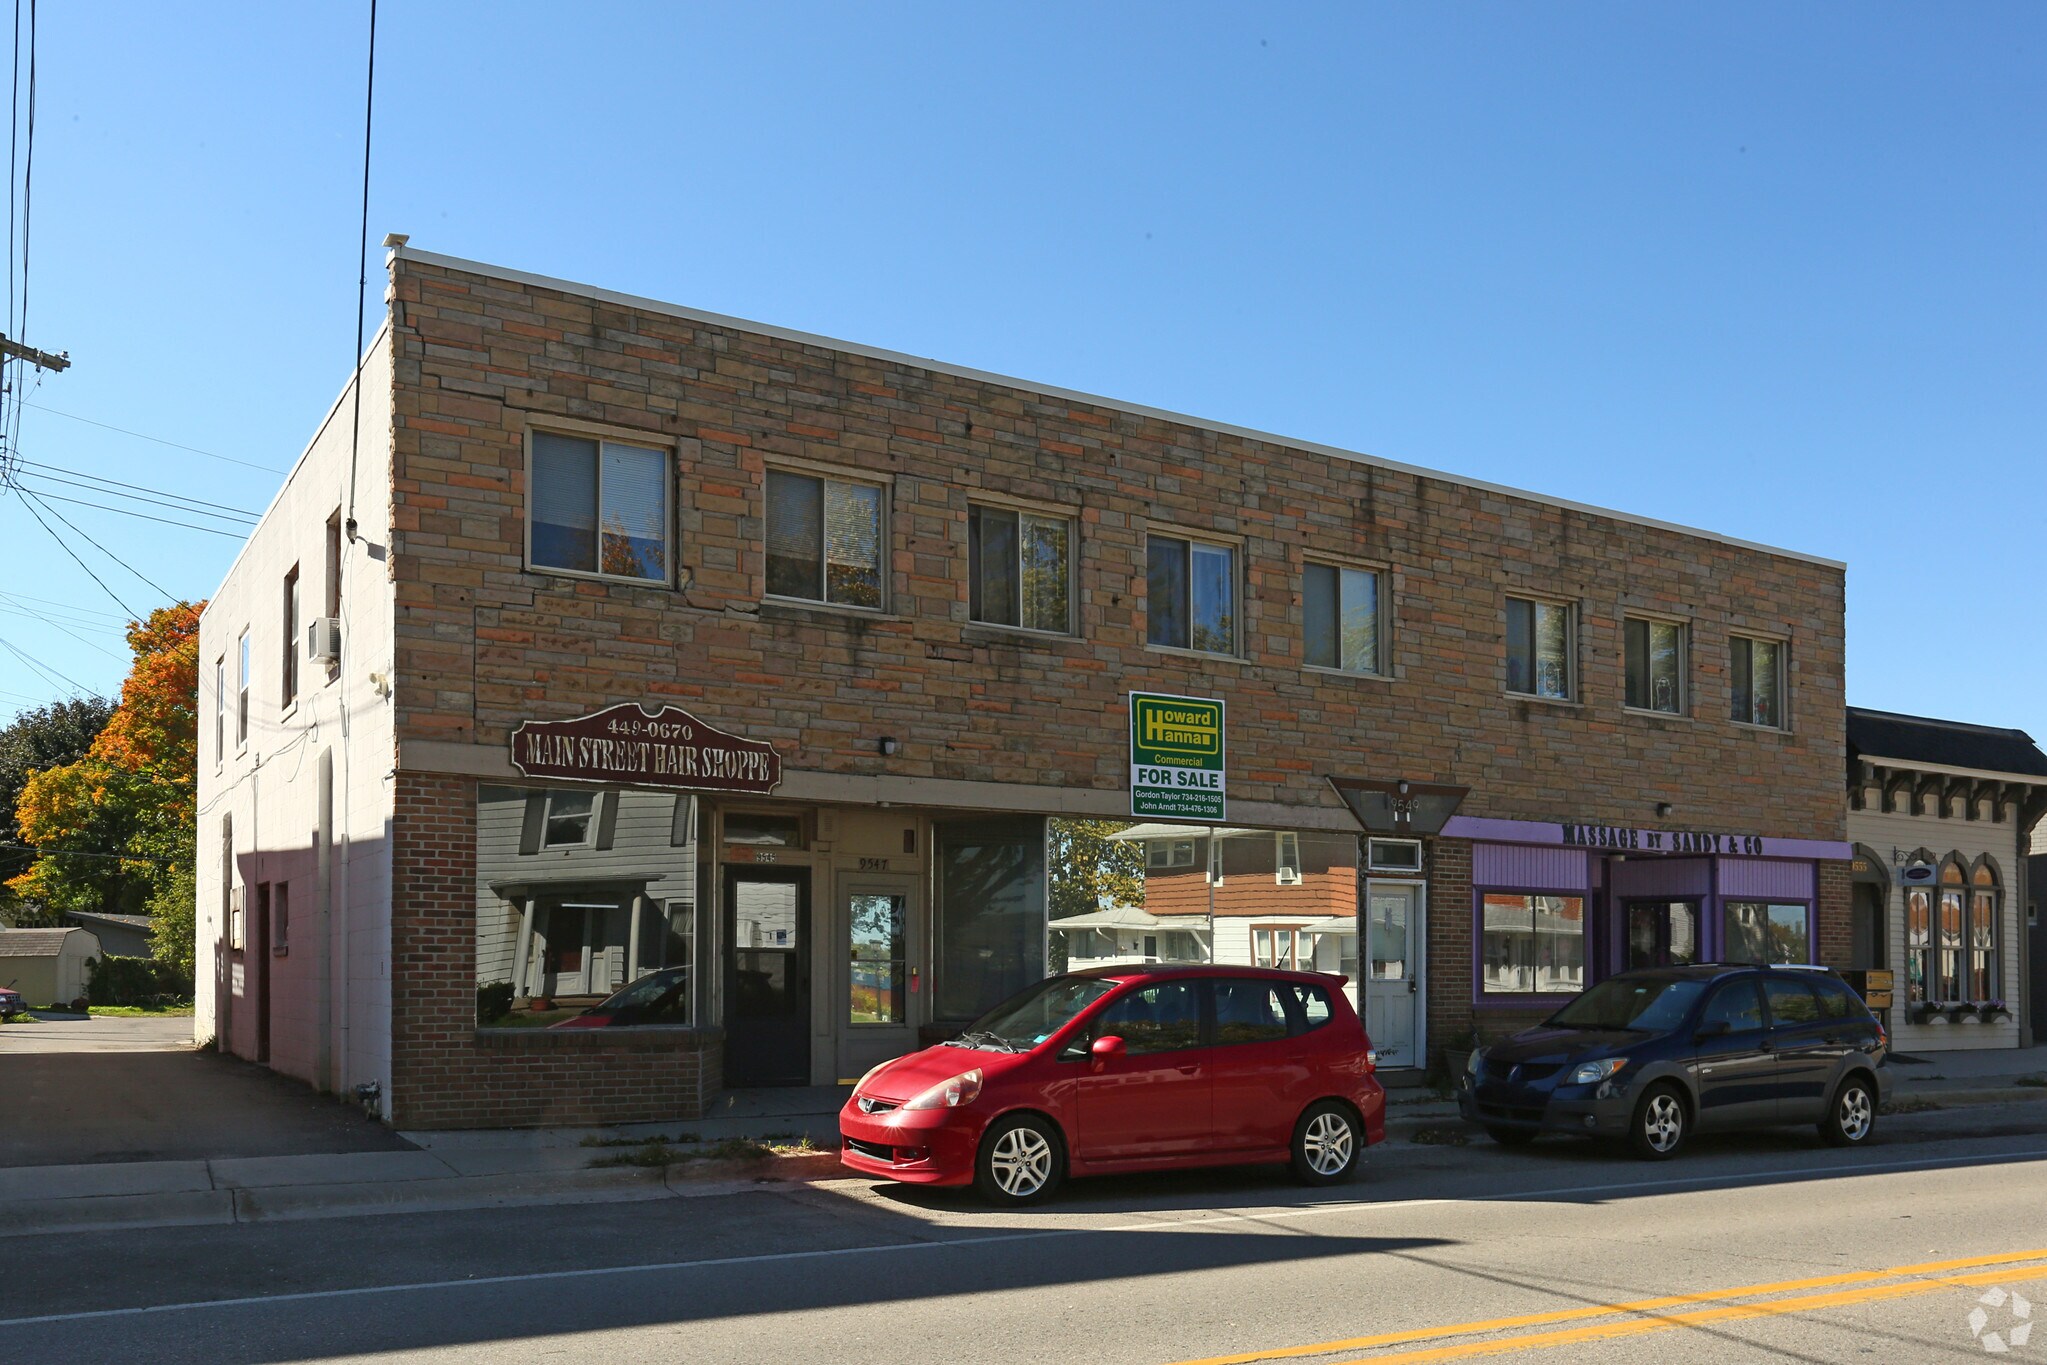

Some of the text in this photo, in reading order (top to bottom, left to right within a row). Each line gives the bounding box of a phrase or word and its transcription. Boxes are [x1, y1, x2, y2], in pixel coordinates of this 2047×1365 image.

[607, 718, 693, 741] 449-0670
[526, 733, 770, 782] MAIN STREET HAIR SHOPPE
[1154, 754, 1203, 767] Commercial
[1138, 768, 1219, 789] FOR SALE
[1135, 790, 1222, 803] Gordon Taylor 734-216-1505
[1140, 801, 1218, 814] John Arndt 734-476-1306
[1391, 797, 1420, 813] 9549
[1562, 824, 1763, 856] MASSAGE BY SANDY & CO
[859, 857, 888, 870] 9547
